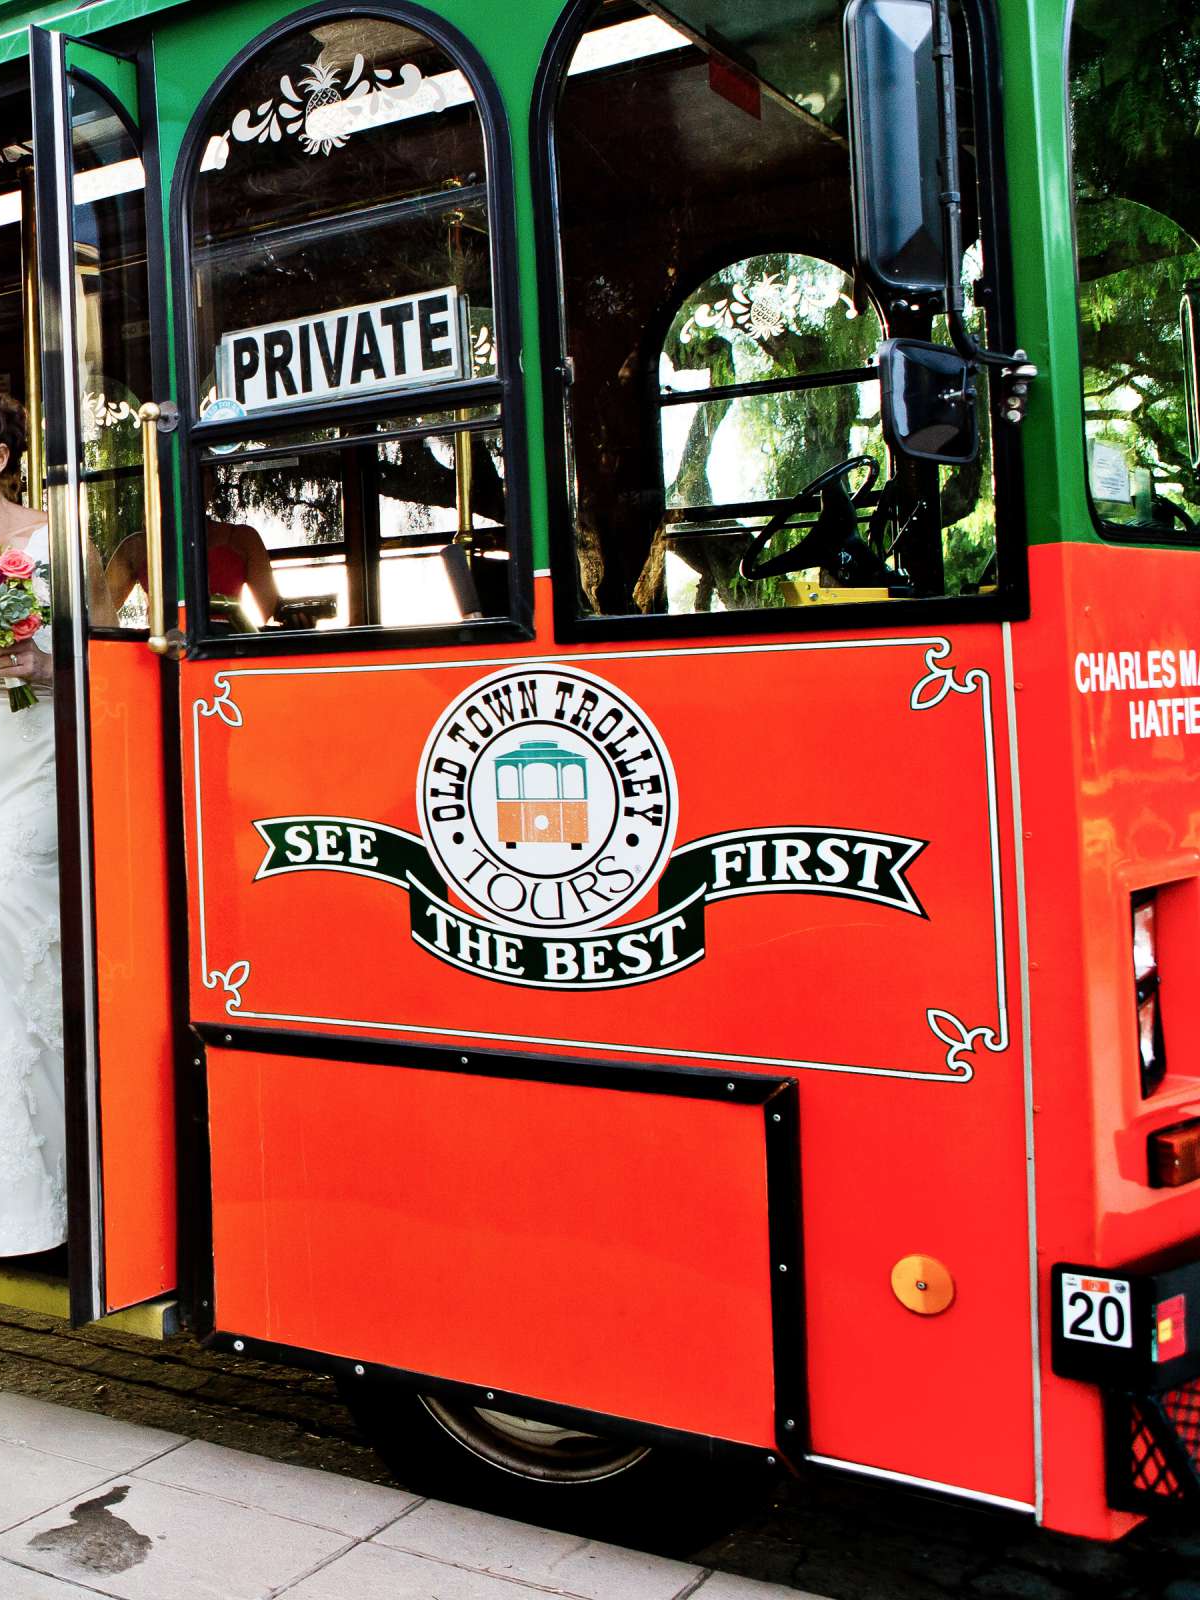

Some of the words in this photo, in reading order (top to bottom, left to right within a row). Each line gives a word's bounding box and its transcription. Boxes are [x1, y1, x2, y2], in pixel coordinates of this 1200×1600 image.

[233, 294, 453, 405] PRIVATE
[1074, 650, 1177, 694] CHARLES
[1179, 649, 1200, 688] M
[447, 679, 539, 754] TOWN
[430, 757, 468, 823] OLD
[554, 681, 664, 827] TROLLEY
[284, 824, 379, 867] SEE
[426, 904, 525, 976] THE
[542, 915, 686, 980] BEST
[711, 837, 893, 890] FIRST
[464, 848, 635, 921] TOURS
[1069, 1291, 1125, 1342] 20
